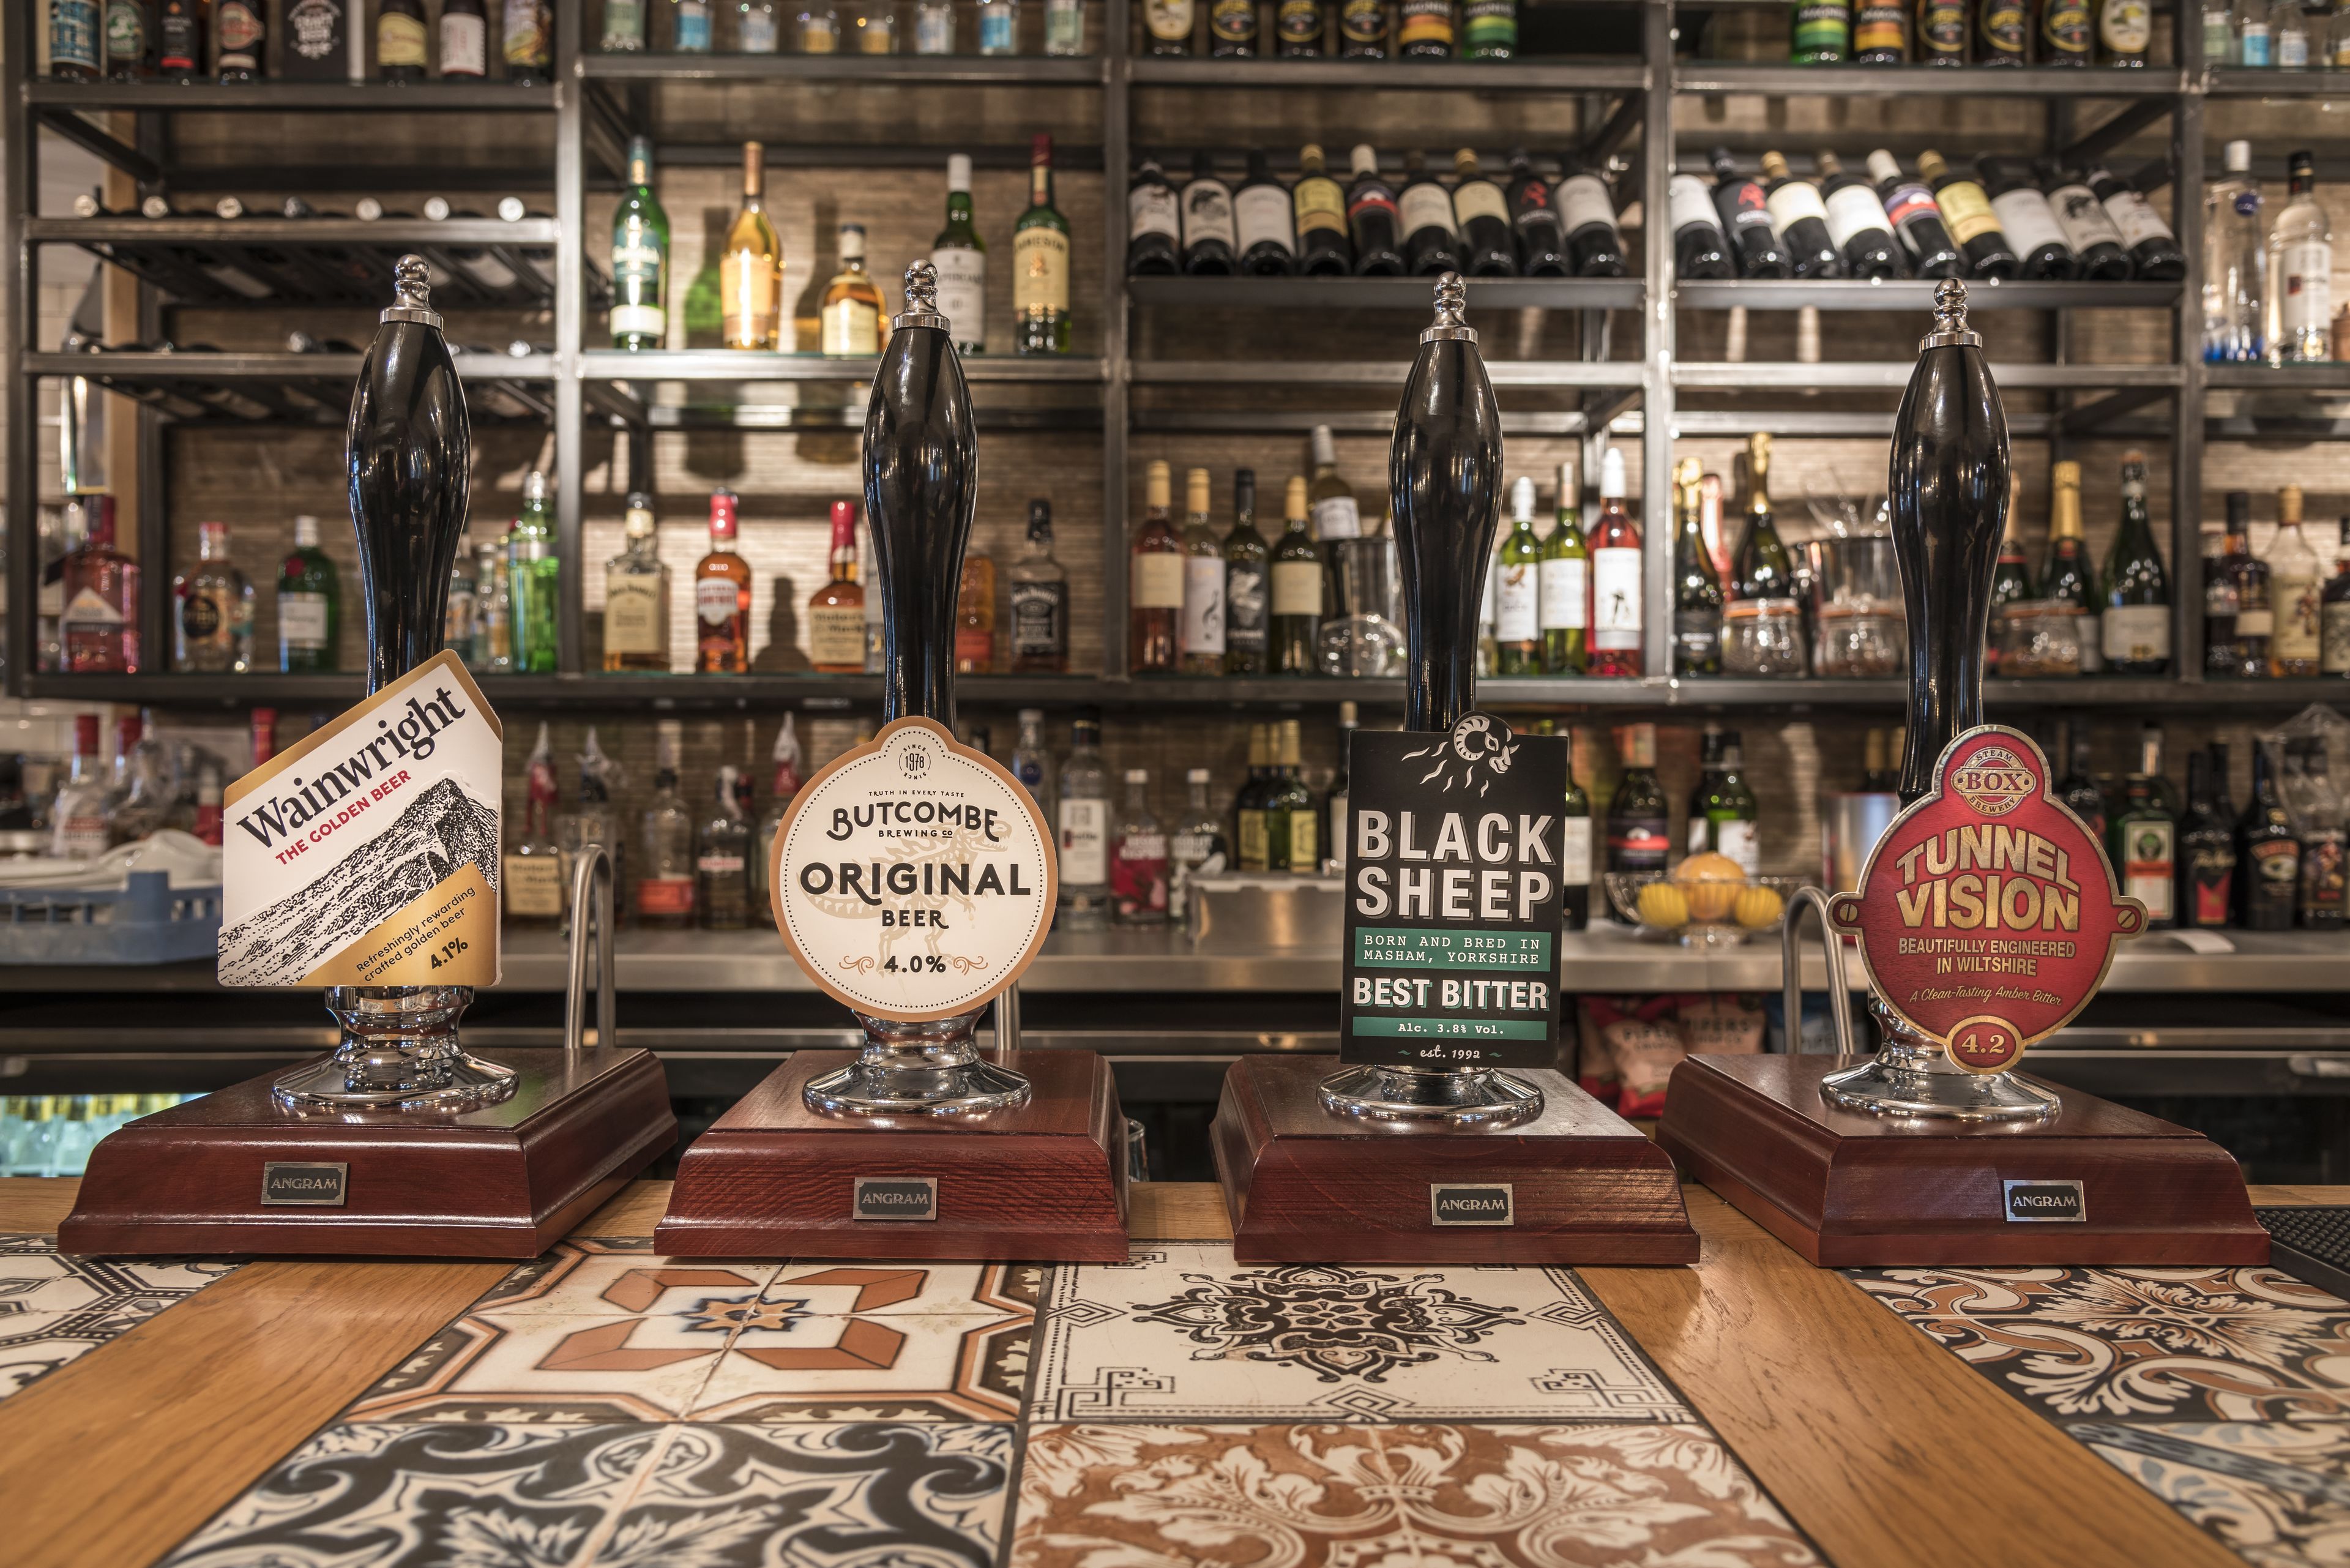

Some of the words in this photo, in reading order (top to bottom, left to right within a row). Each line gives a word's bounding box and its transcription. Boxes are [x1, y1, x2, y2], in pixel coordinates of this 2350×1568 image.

[905, 753, 924, 771] 1978
[1976, 750, 2012, 761] STEAM
[236, 687, 465, 848] Wainwright
[1966, 772, 2023, 791] BOX
[1969, 796, 2016, 813] BREWERY
[275, 838, 308, 865] THE
[309, 797, 370, 843] GOLDEN
[371, 770, 411, 802] BEER
[826, 801, 999, 843] BUTCOMBE
[1358, 810, 1556, 865] BLACK
[1897, 824, 2080, 894] TUNNEL
[800, 862, 1031, 906] ORIGINAL
[1356, 866, 1553, 922] SHEEP
[1895, 874, 2080, 931] VISION
[356, 925, 419, 972] Refreshingly
[421, 887, 476, 927] rewarding
[882, 910, 949, 929] BEER
[365, 952, 403, 981] crafted
[405, 927, 441, 955] golden
[440, 908, 464, 929] beer
[1365, 935, 1406, 946] BORN
[1419, 937, 1450, 947] AND
[1464, 938, 1505, 948] BRED
[1521, 939, 1539, 949] IN
[1898, 938, 1986, 955] BEAUTIFULLY
[1990, 939, 2076, 959] ENGINEERED
[431, 938, 468, 969] 4.1%
[1364, 950, 1433, 963] MASHAM,
[1447, 952, 1539, 964] YORKSHIRE
[884, 955, 946, 973] 4.0%
[1936, 957, 1952, 974] IN
[1956, 955, 2037, 977] WILTSHIRE
[1354, 977, 1433, 1007] BEST
[1442, 980, 1550, 1010] BITTER
[1909, 990, 1919, 1003] A
[1921, 985, 1992, 1003] Clean-Tasting
[1995, 986, 2030, 1000] Amber
[2032, 990, 2062, 1006] Bitter
[1398, 1023, 1427, 1032] Alc.
[1438, 1024, 1466, 1033] 3.8%
[1475, 1025, 1504, 1034] Vol.
[1420, 1045, 1445, 1058] est.
[1452, 1050, 1480, 1059] 1992
[1961, 1034, 2005, 1053] 4.2
[270, 1178, 338, 1189] ANGRAM
[862, 1193, 928, 1204] ANGRAM
[1440, 1200, 1505, 1211] ANGRAM
[2013, 1196, 2077, 1207] ANGRAM
